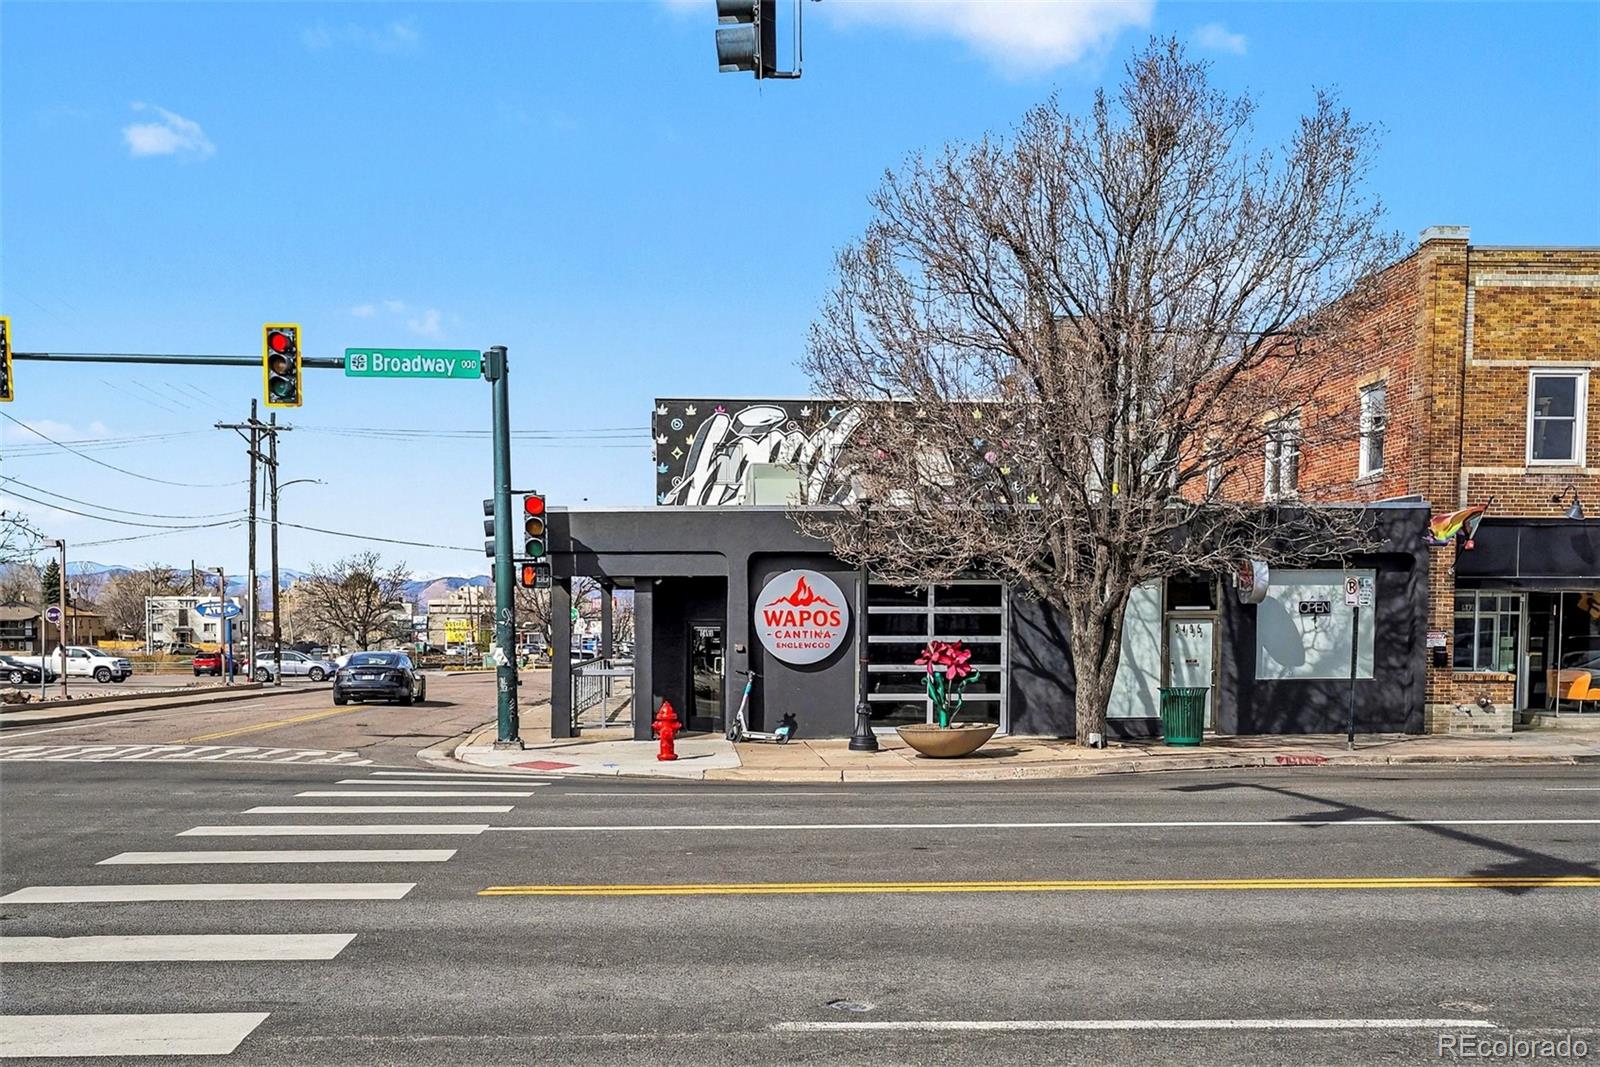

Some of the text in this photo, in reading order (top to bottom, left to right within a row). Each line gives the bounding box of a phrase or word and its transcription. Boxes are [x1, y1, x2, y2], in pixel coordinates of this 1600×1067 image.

[372, 354, 456, 376] Broadway
[1300, 602, 1331, 613] OPEN
[763, 610, 841, 627] WAPOS
[775, 631, 832, 639] CANTINA
